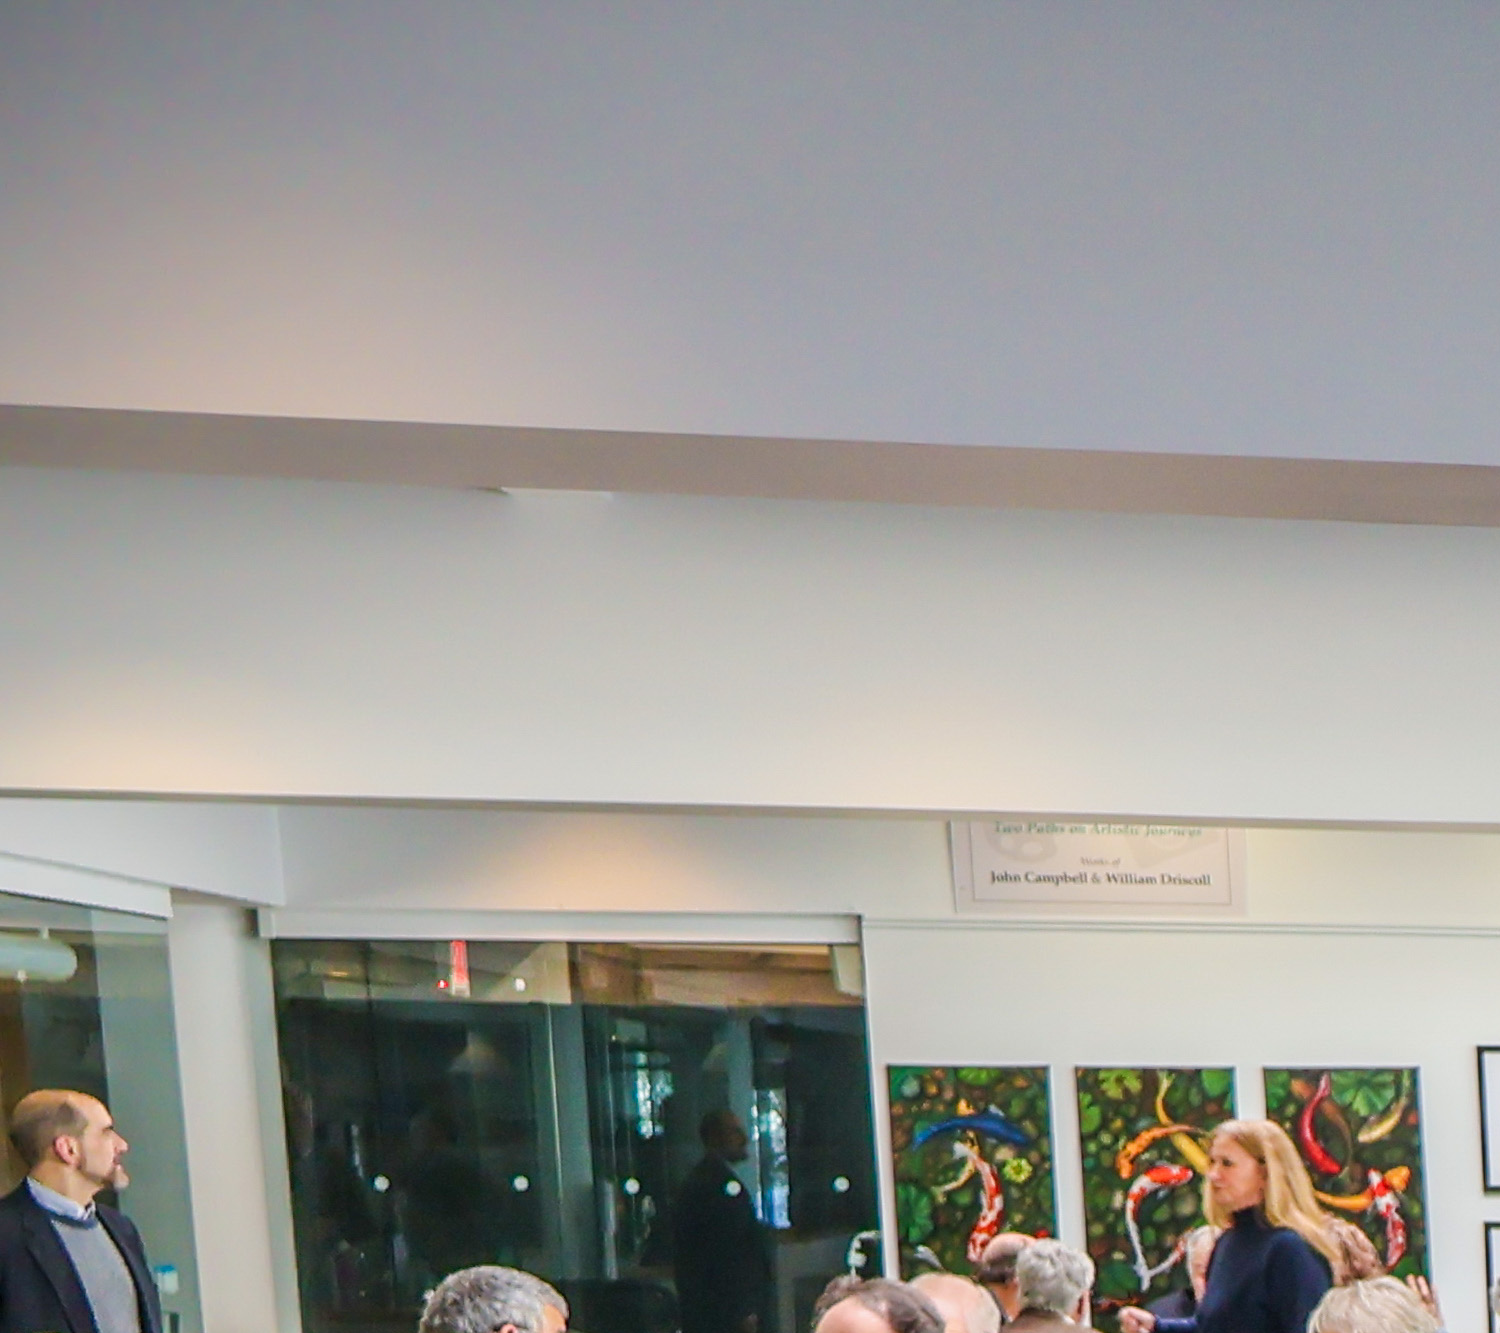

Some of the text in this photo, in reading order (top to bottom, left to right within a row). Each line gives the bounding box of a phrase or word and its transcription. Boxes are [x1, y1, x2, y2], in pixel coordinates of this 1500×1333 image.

[991, 870, 1211, 887] John Campbell & William Driscoll
